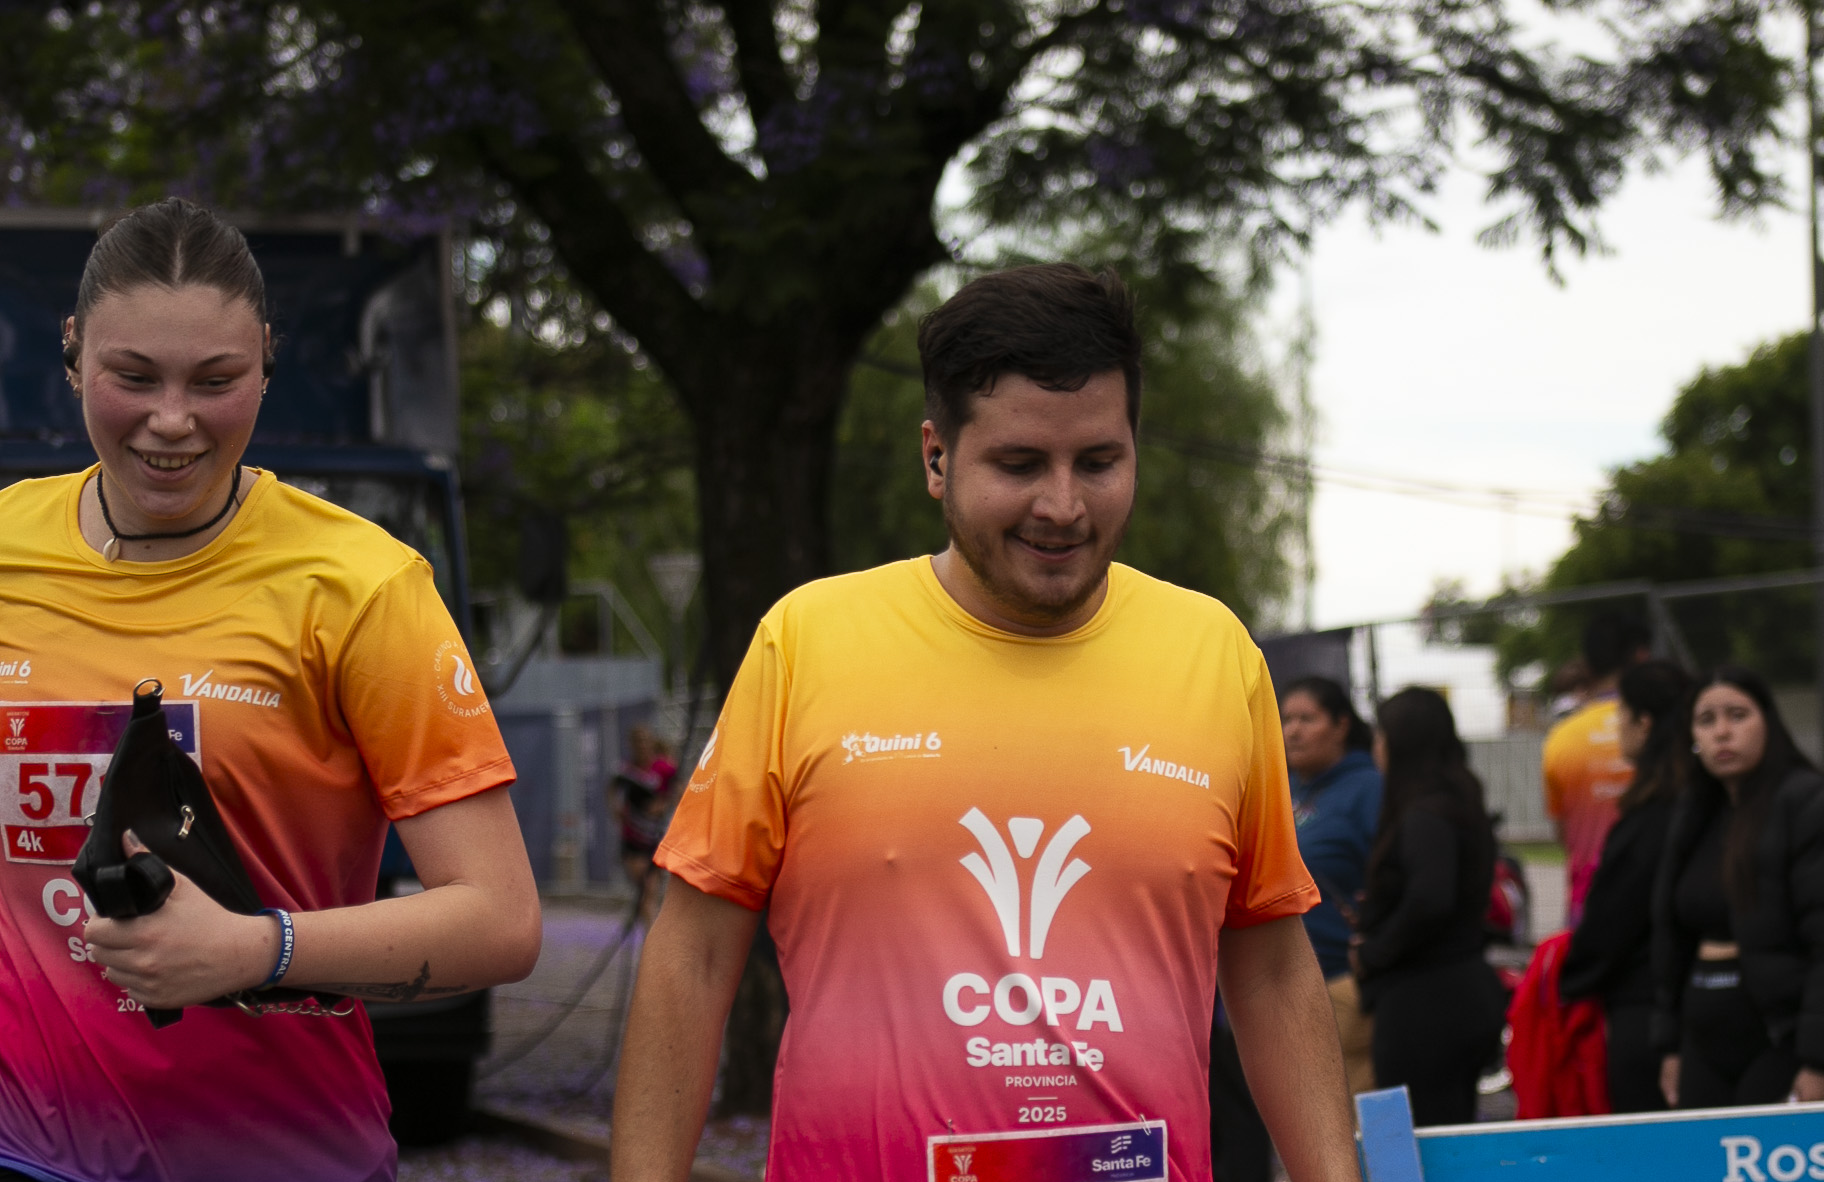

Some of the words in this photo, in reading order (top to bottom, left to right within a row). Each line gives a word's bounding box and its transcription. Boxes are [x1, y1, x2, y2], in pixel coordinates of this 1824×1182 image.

[0, 661, 19, 677] ini
[19, 660, 32, 678] 6
[179, 669, 281, 709] VANDALIA
[4, 737, 28, 746] COPA
[865, 732, 923, 754] Quini
[925, 731, 942, 751] 6
[1118, 744, 1210, 790] VANDALIA
[19, 763, 106, 820] 57
[17, 829, 44, 853] 4k
[275, 927, 293, 977] CENTRAL
[942, 972, 1124, 1032] COPA
[966, 1036, 1070, 1068] Santa
[1070, 1040, 1104, 1072] Fe
[1005, 1074, 1078, 1088] PROVINCIA
[1018, 1106, 1067, 1123] 2025
[1092, 1157, 1134, 1172] Santa
[1135, 1154, 1151, 1167] Fe
